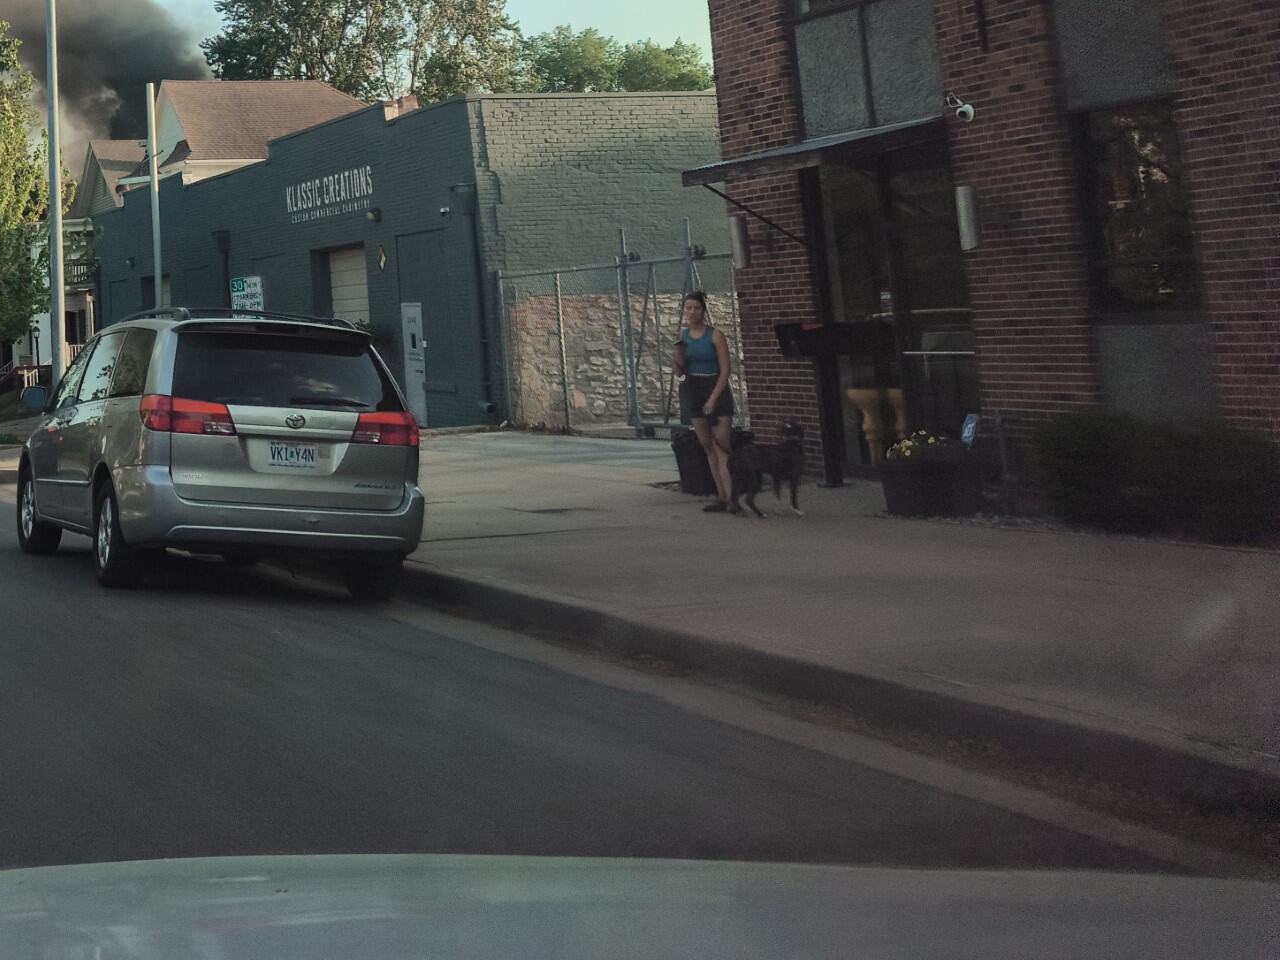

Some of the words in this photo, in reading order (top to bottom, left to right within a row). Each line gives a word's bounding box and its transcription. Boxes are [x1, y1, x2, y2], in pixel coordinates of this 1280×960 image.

[286, 179, 321, 213] KLASSIC
[323, 165, 373, 205] CREATIONS
[232, 281, 243, 291] 30
